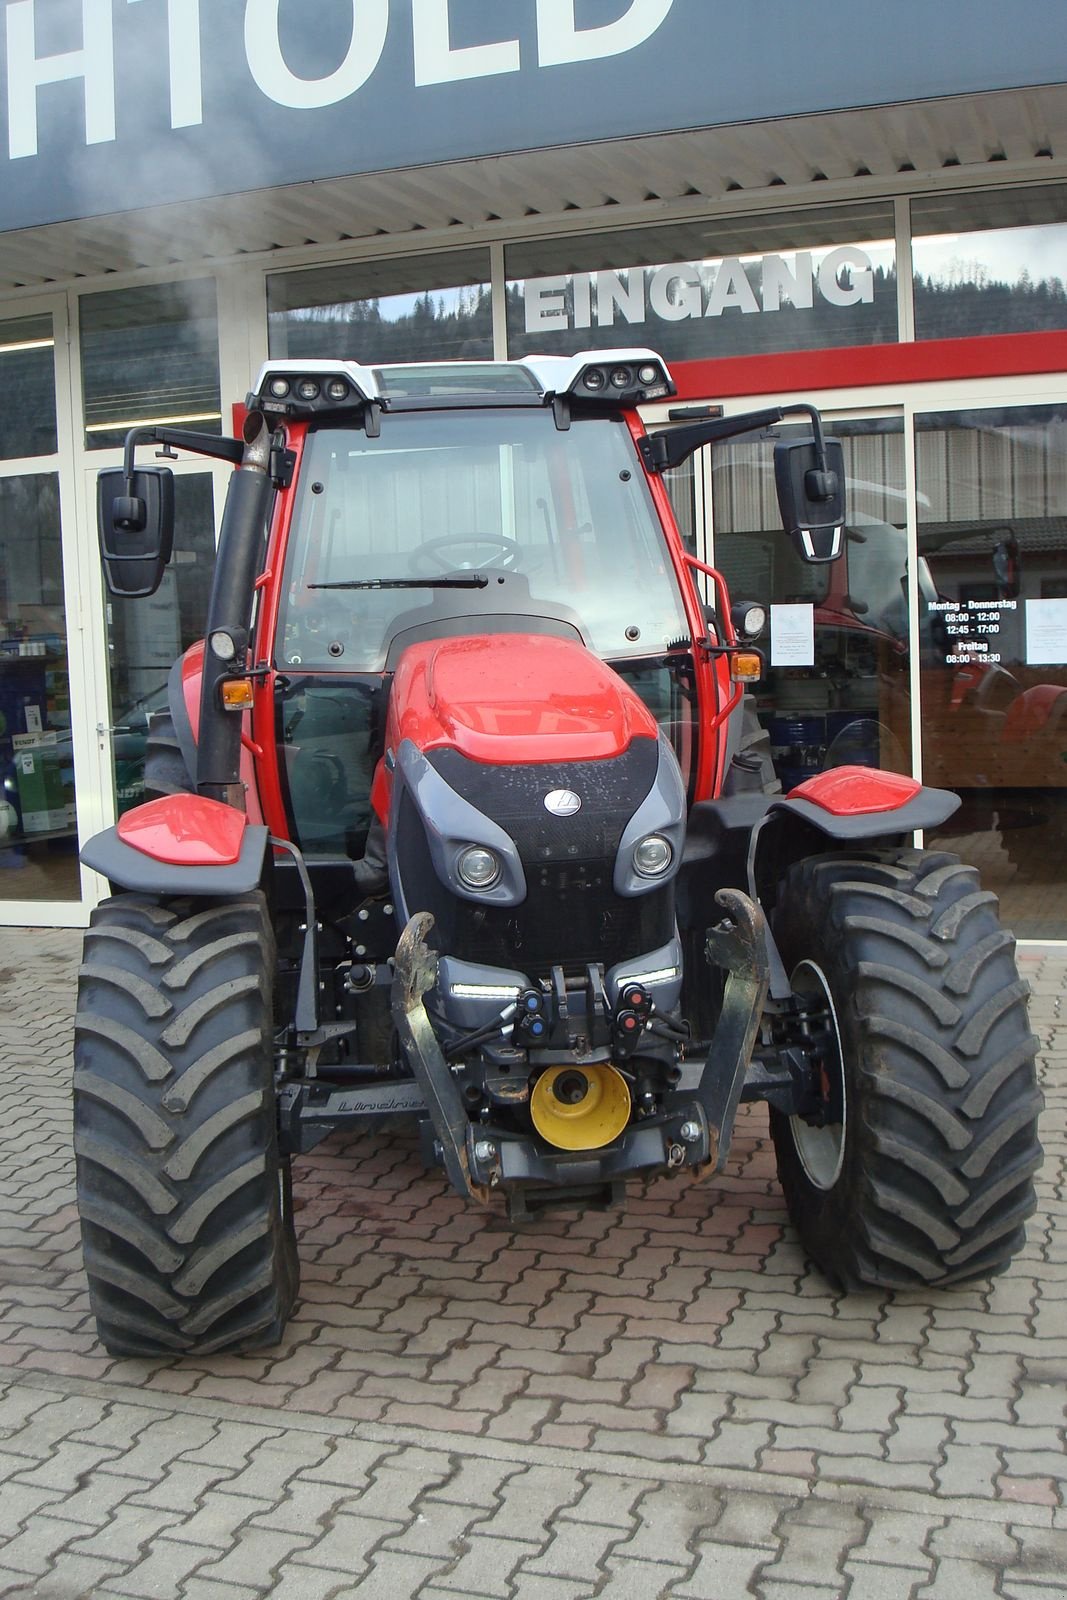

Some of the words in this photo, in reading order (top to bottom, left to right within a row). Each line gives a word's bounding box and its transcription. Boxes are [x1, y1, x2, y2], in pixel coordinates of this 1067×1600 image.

[524, 245, 874, 333] EINGANG
[928, 601, 960, 611] Montag
[968, 599, 1017, 610] Donnerstag
[945, 613, 969, 622] 08:00
[976, 612, 1000, 621] 12:00
[946, 625, 969, 634] 12:45
[977, 624, 1000, 633] 17:00
[958, 641, 988, 652] Freitag
[946, 654, 970, 663] 08:00
[978, 653, 1001, 662] 13:30
